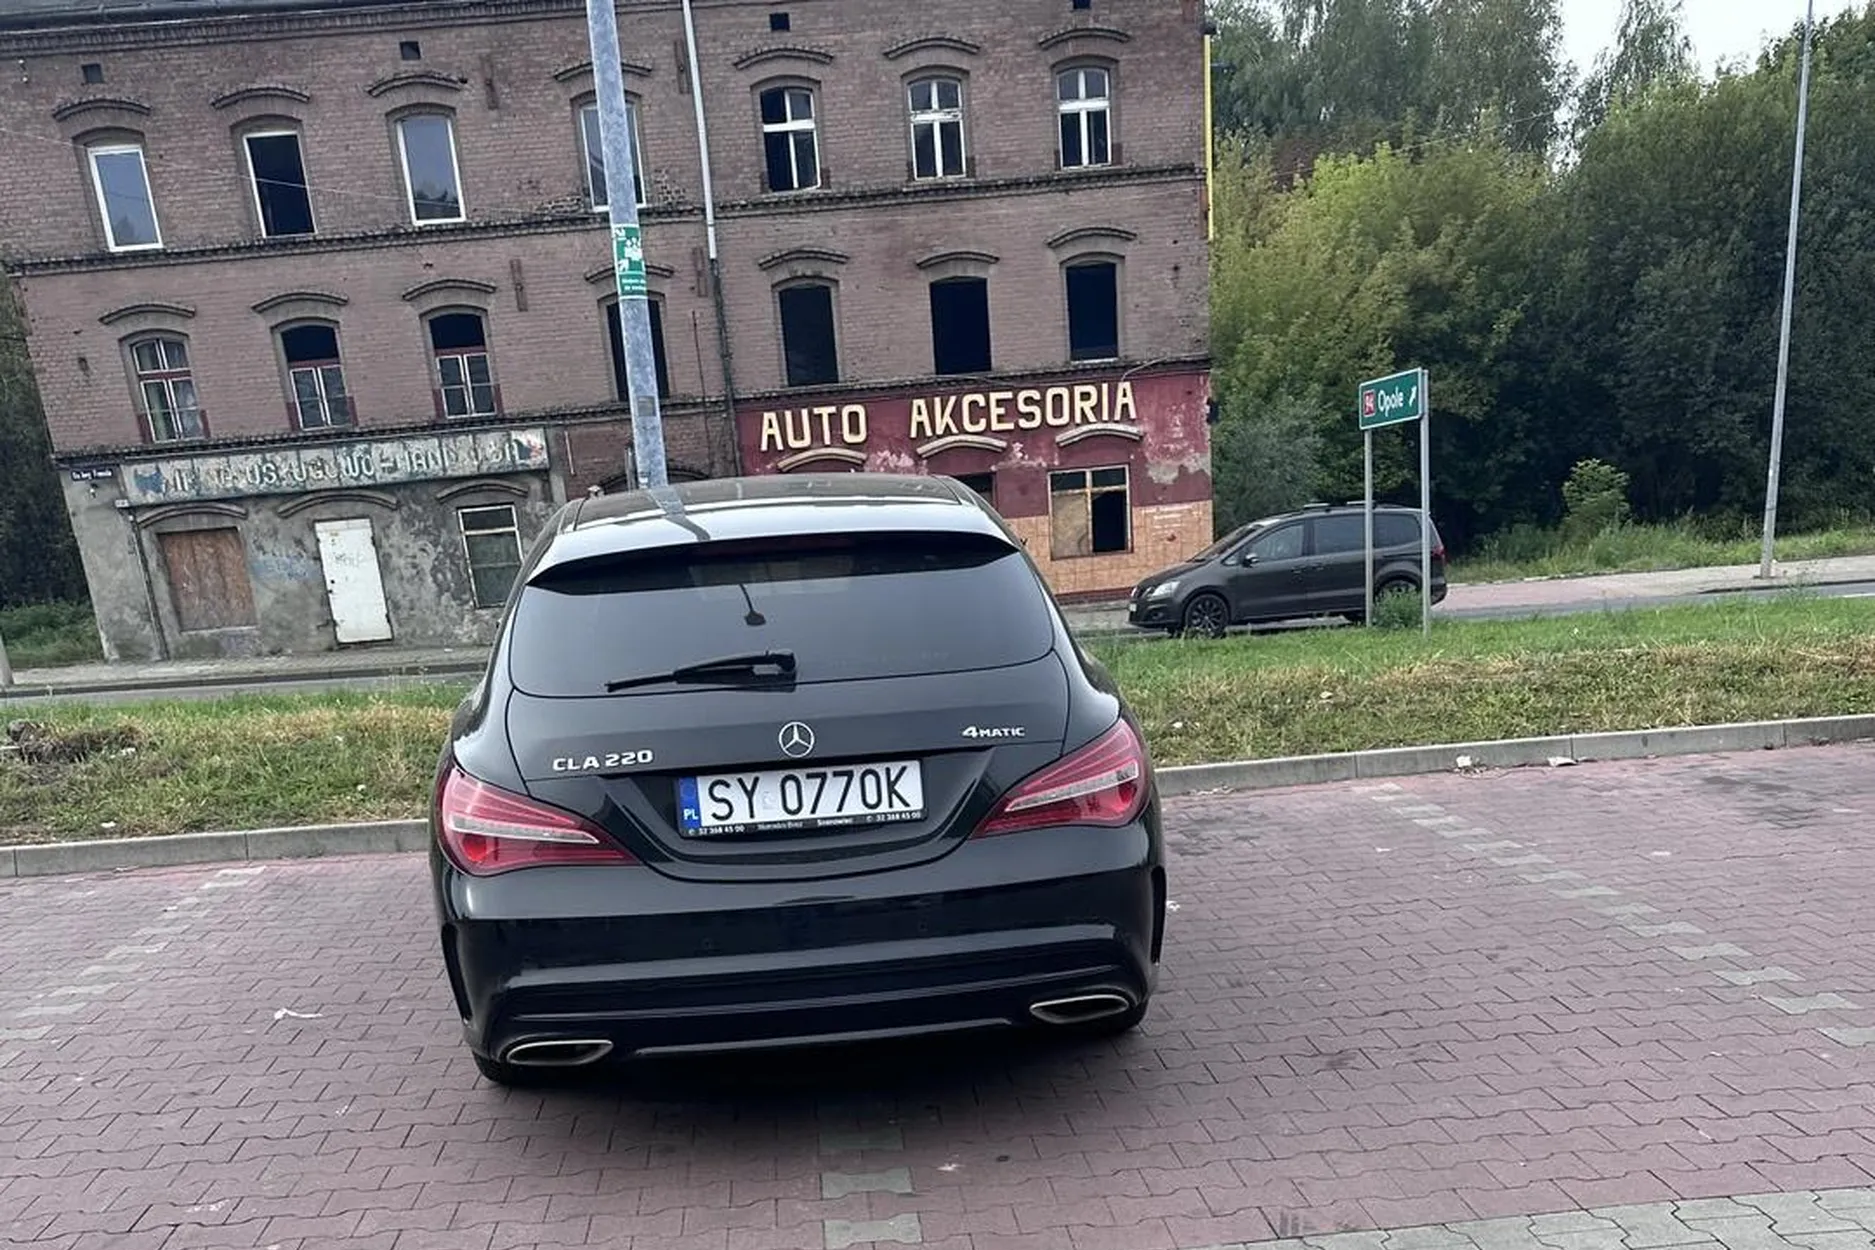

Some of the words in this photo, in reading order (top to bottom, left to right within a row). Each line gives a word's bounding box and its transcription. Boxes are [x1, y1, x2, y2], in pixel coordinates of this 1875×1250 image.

[1378, 386, 1404, 417] Opole
[760, 403, 868, 452] AUTO
[910, 381, 1138, 439] AKCESORIA
[961, 726, 1026, 738] 4MATIC
[552, 756, 600, 771] CLA
[605, 750, 653, 767] 220
[708, 776, 760, 821] SY
[780, 765, 911, 816] 0770K
[683, 808, 699, 820] PL
